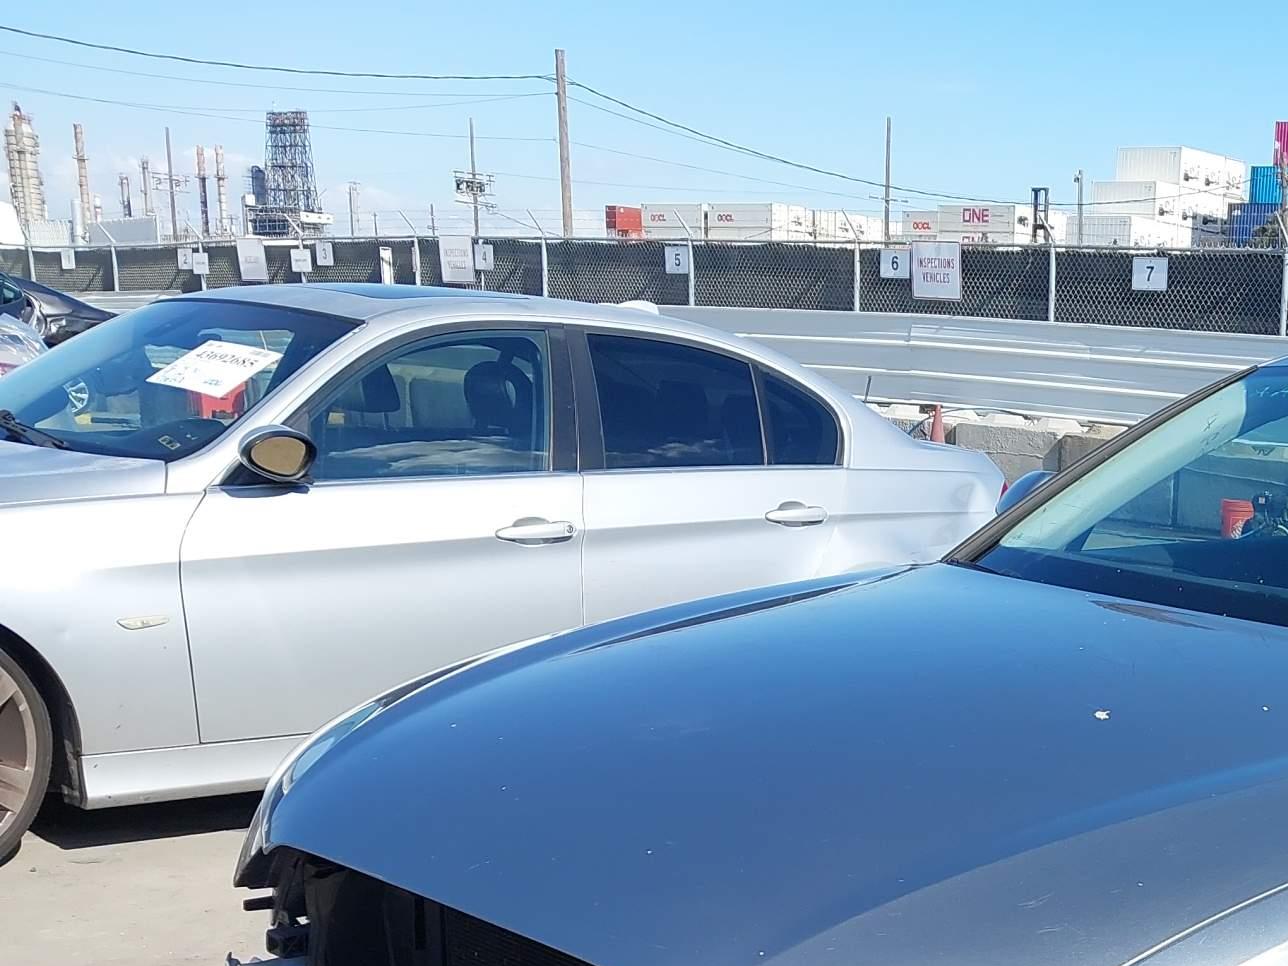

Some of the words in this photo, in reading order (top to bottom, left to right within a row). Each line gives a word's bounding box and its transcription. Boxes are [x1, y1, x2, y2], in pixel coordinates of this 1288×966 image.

[962, 208, 990, 223] ONE
[674, 253, 681, 267] 5
[891, 255, 899, 271] 6
[917, 257, 955, 269] INSPECTIONS
[922, 271, 950, 284] VEHICLES
[1145, 265, 1155, 282] 7
